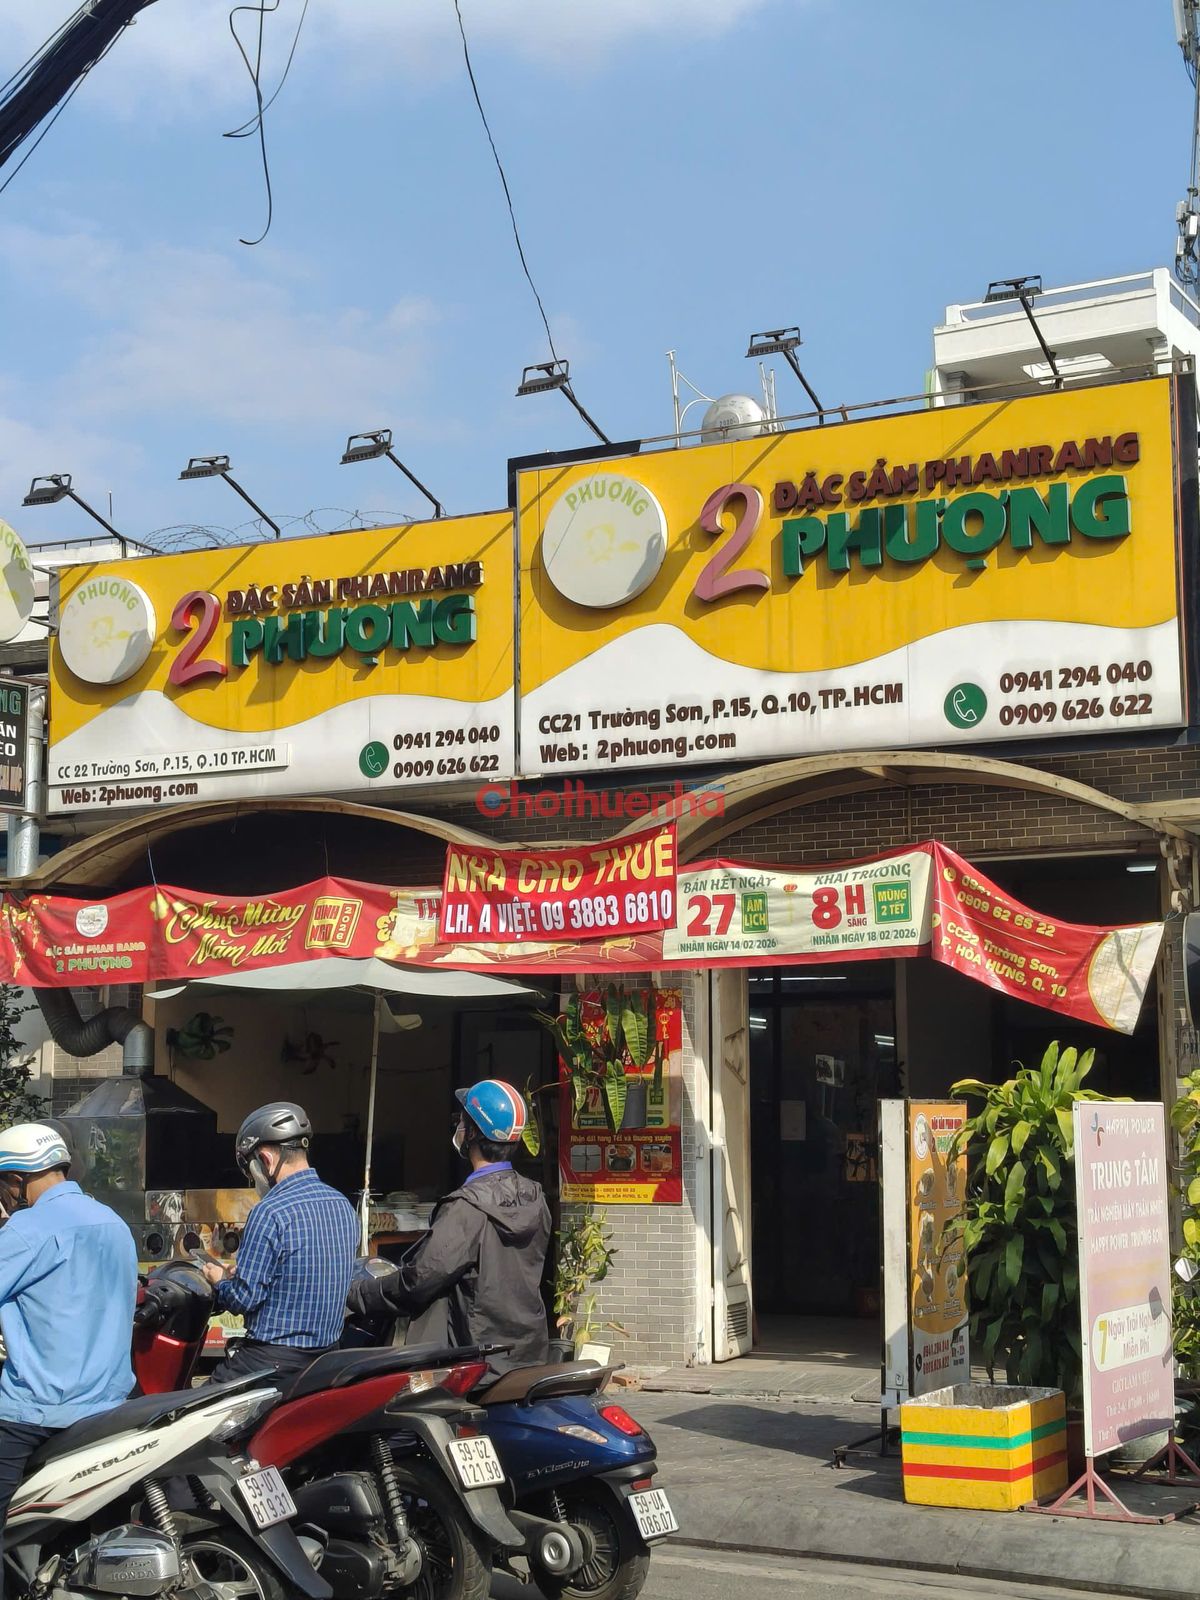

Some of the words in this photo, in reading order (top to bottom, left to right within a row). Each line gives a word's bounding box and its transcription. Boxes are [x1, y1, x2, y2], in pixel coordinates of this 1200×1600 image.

[774, 471, 843, 511] ĐẶC
[850, 458, 919, 501] SẢN
[925, 432, 1139, 489] PHANRANG
[694, 482, 771, 602] 2
[782, 475, 1132, 576] PHƯỢNG
[227, 583, 278, 615] ĐẶC
[282, 575, 333, 607] SẢN
[337, 561, 484, 601] PHANRANG
[170, 590, 228, 686] 2
[231, 594, 477, 667] PHƯỢNG
[1000, 670, 1053, 694] 0941
[1059, 666, 1101, 689] 294
[1106, 660, 1153, 684] 040
[538, 713, 581, 735] CC21
[588, 707, 660, 730] Trường
[665, 702, 710, 725] Sơn,
[713, 697, 757, 720] P.15,
[761, 692, 817, 717] Q.10,
[819, 683, 903, 710] TP.HCM
[999, 702, 1057, 726] 0909
[1062, 698, 1104, 721] 626
[1110, 693, 1152, 717] 622
[393, 732, 431, 750] 0941
[435, 728, 465, 747] 294
[468, 725, 500, 744] 040
[539, 744, 588, 764] Web:
[597, 732, 737, 763] 2phuong.com
[58, 765, 70, 779] CC
[74, 764, 88, 778] 22
[91, 760, 130, 777] Trường
[135, 759, 159, 773] Sơn,
[163, 755, 192, 771] P.15,
[197, 752, 228, 769] Q.10
[231, 748, 276, 764] TP.HCM
[393, 760, 434, 778] 0909
[437, 757, 466, 775] 626
[469, 754, 499, 772] 622
[61, 788, 96, 804] Web:
[99, 782, 198, 805] 2phuong.com
[517, 858, 584, 894] CHO
[589, 827, 674, 886] THUÊ
[683, 878, 707, 894] BÁN
[711, 874, 737, 890] HẾT
[814, 872, 848, 885] KHAI
[444, 903, 473, 934] LH.
[478, 903, 491, 933] A
[497, 896, 537, 939] VIỆT:
[540, 901, 565, 931] 09
[570, 897, 620, 929] 3883
[625, 889, 672, 924] 6810
[687, 894, 736, 937] 27
[881, 906, 888, 916] 2
[957, 891, 990, 913] 0909
[992, 906, 1011, 921] 62
[1036, 923, 1056, 937] 22
[56, 960, 64, 972] 2
[68, 956, 132, 973] PHƯỢNG
[947, 922, 979, 946] CC22
[1029, 958, 1059, 979] Sơn,
[955, 944, 982, 965] HÒA
[1051, 984, 1067, 997] 10
[1090, 1160, 1132, 1191] TRUNG
[1135, 1152, 1159, 1187] TÂM
[69, 1462, 101, 1483] AIR
[102, 1439, 159, 1470] BLADE
[462, 1460, 501, 1484] 121.98
[244, 1471, 278, 1499] 59-U1
[253, 1492, 293, 1523] 819.31
[634, 1491, 665, 1514] 59-UA
[640, 1511, 673, 1535] 086.07
